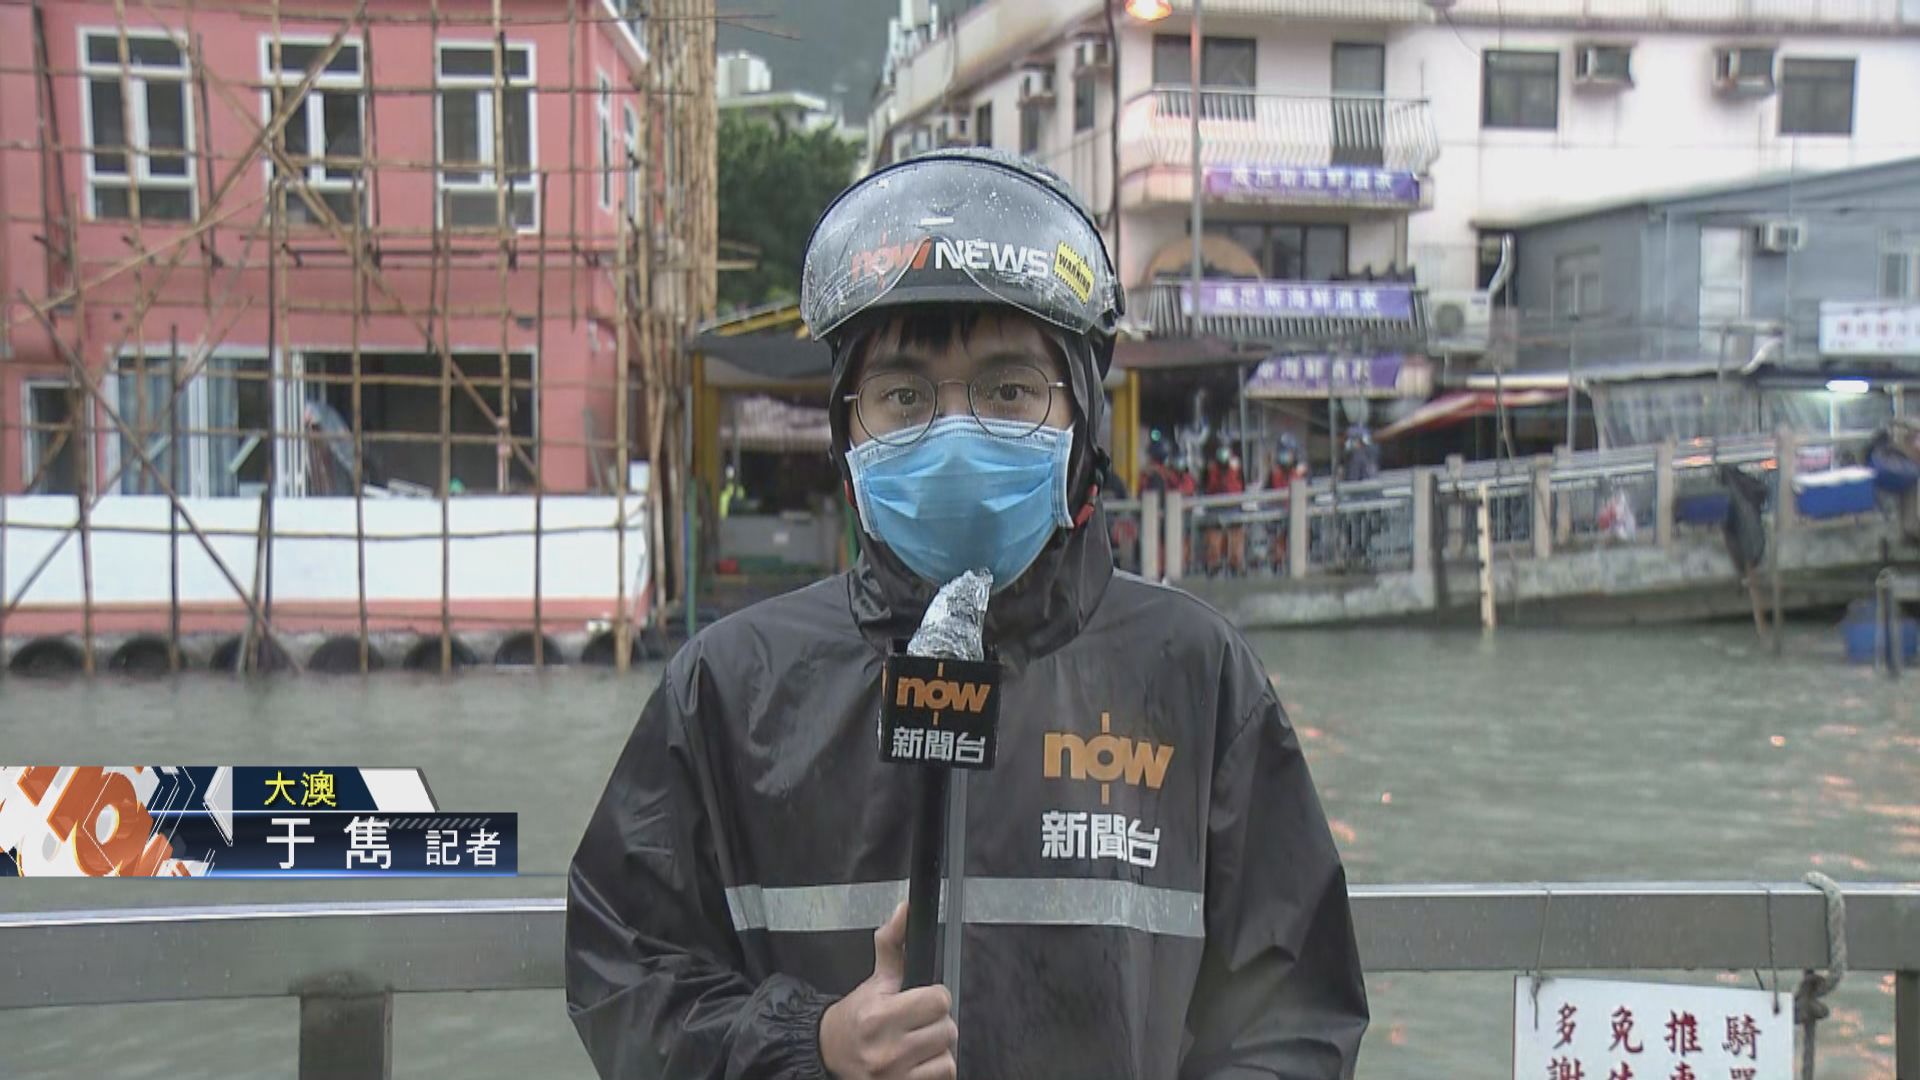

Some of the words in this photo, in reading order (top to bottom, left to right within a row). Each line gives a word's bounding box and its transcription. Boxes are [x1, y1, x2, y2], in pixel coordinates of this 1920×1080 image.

[935, 239, 1049, 279] NEWS
[1058, 253, 1091, 294] WARNING
[896, 676, 991, 713] now
[891, 726, 986, 763] 新聞台
[1044, 732, 1175, 790] now
[1042, 810, 1161, 868] 新聞台
